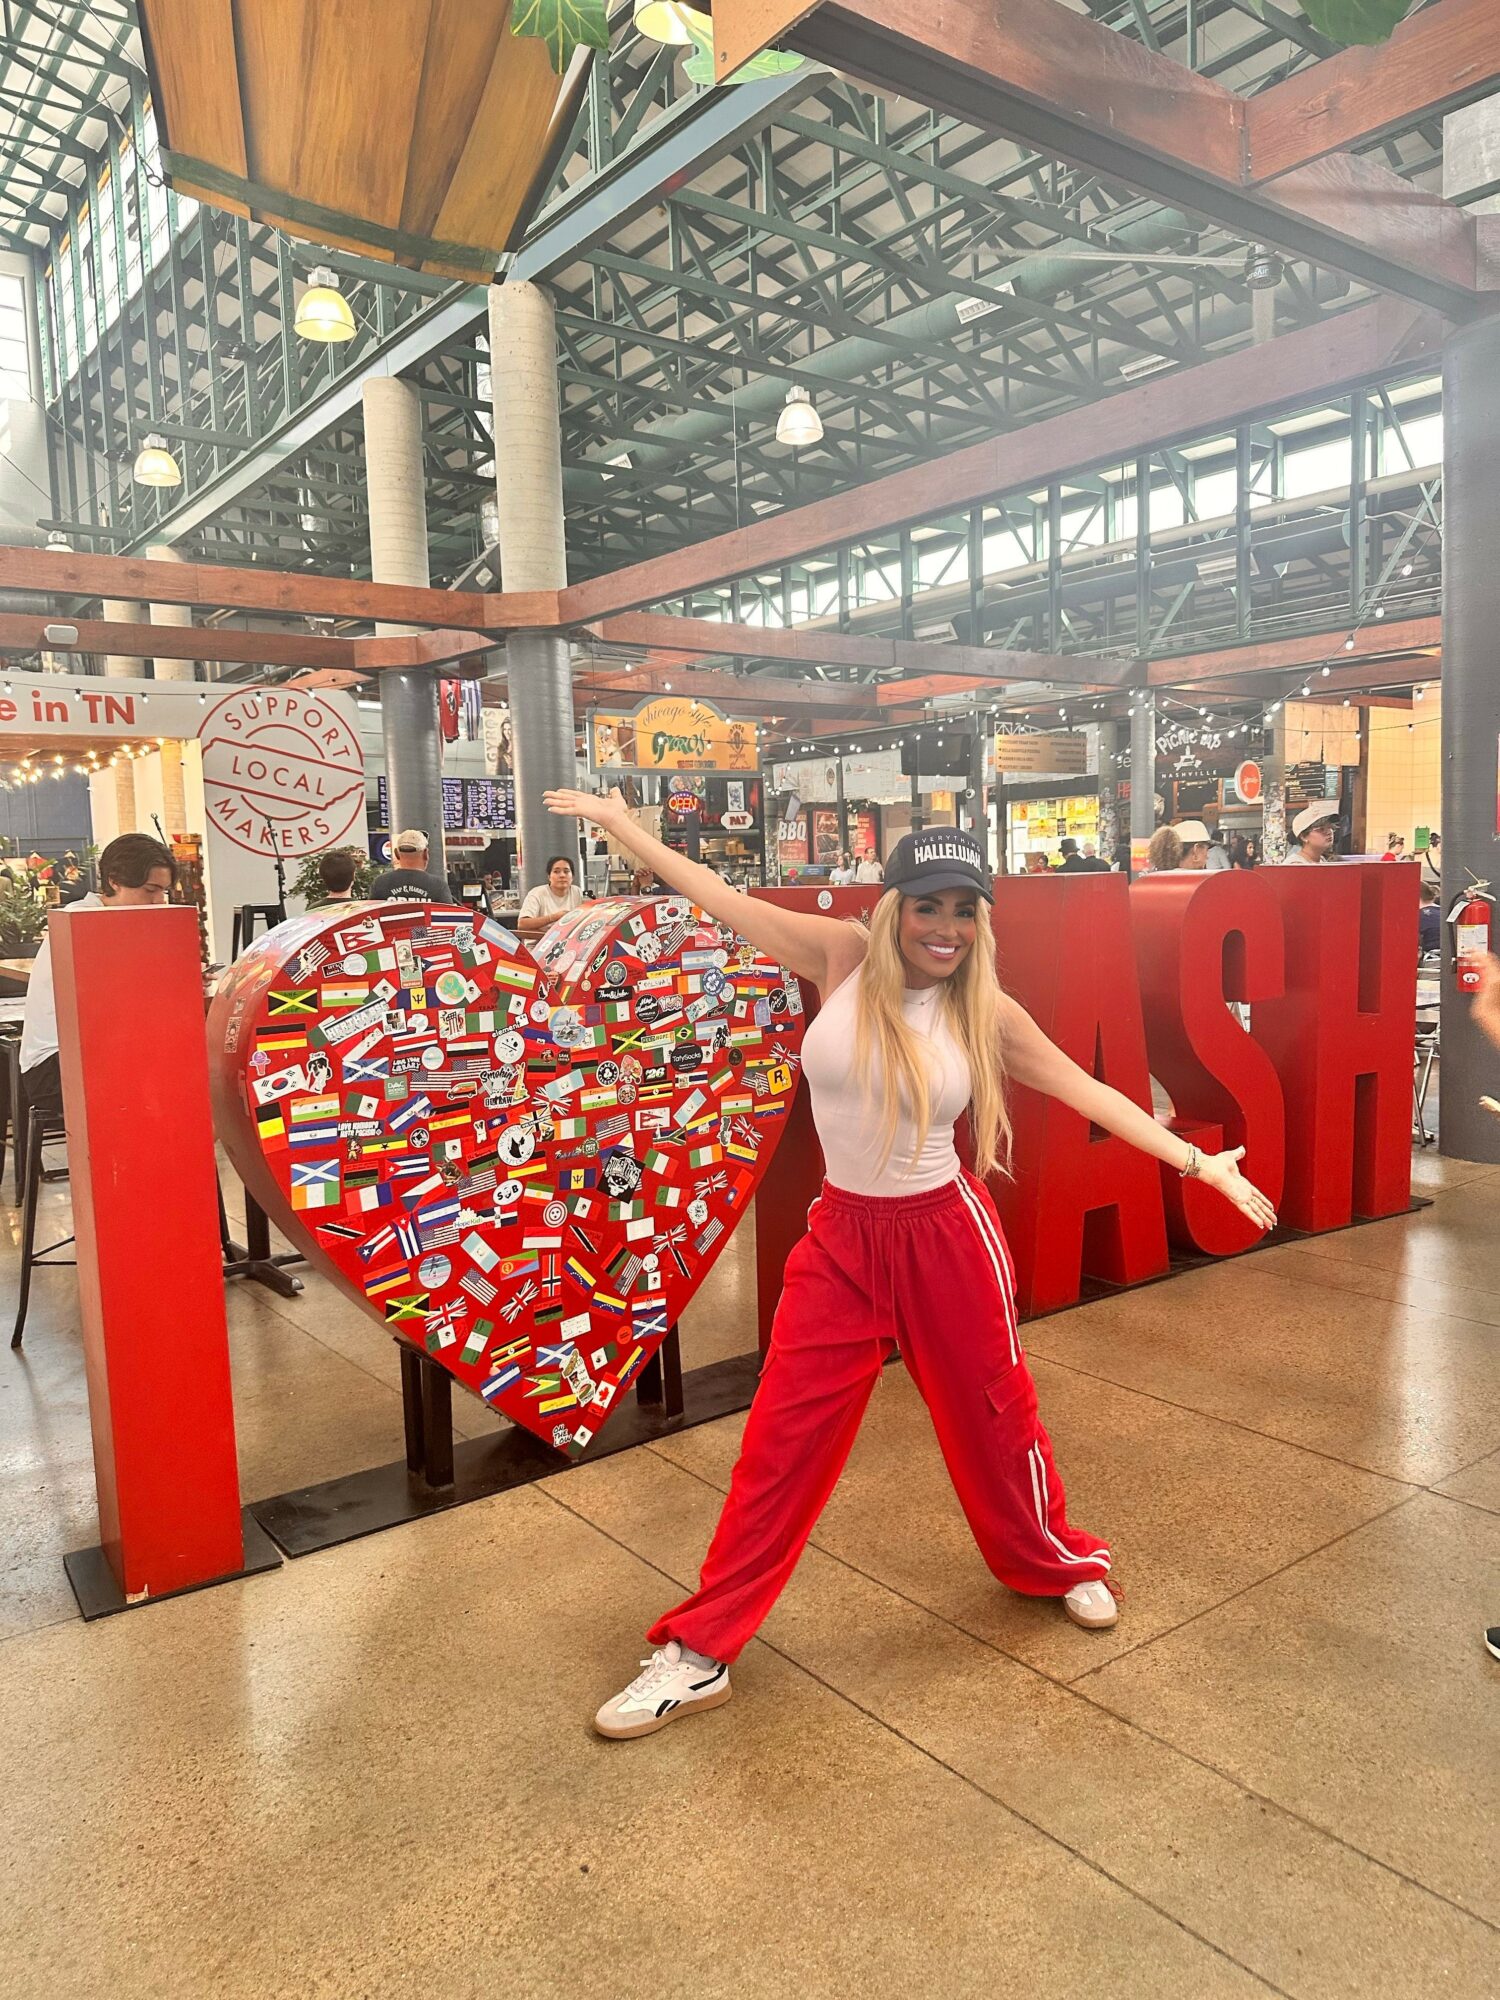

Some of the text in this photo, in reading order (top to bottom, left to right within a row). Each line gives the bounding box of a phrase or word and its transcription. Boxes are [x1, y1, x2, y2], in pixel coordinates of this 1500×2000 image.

[33, 690, 69, 723] in
[82, 694, 136, 725] TN
[224, 696, 350, 758] SUPPORT
[486, 709, 496, 763] GYROS
[232, 755, 326, 797] LOCAL
[1161, 769, 1218, 779] NASHVILLE
[668, 796, 698, 811] OPEN
[214, 798, 330, 848] MAKERS
[729, 815, 747, 825] PAY
[778, 820, 807, 841] BBQ
[914, 834, 981, 852] EVERYTHING
[773, 1069, 785, 1084] R
